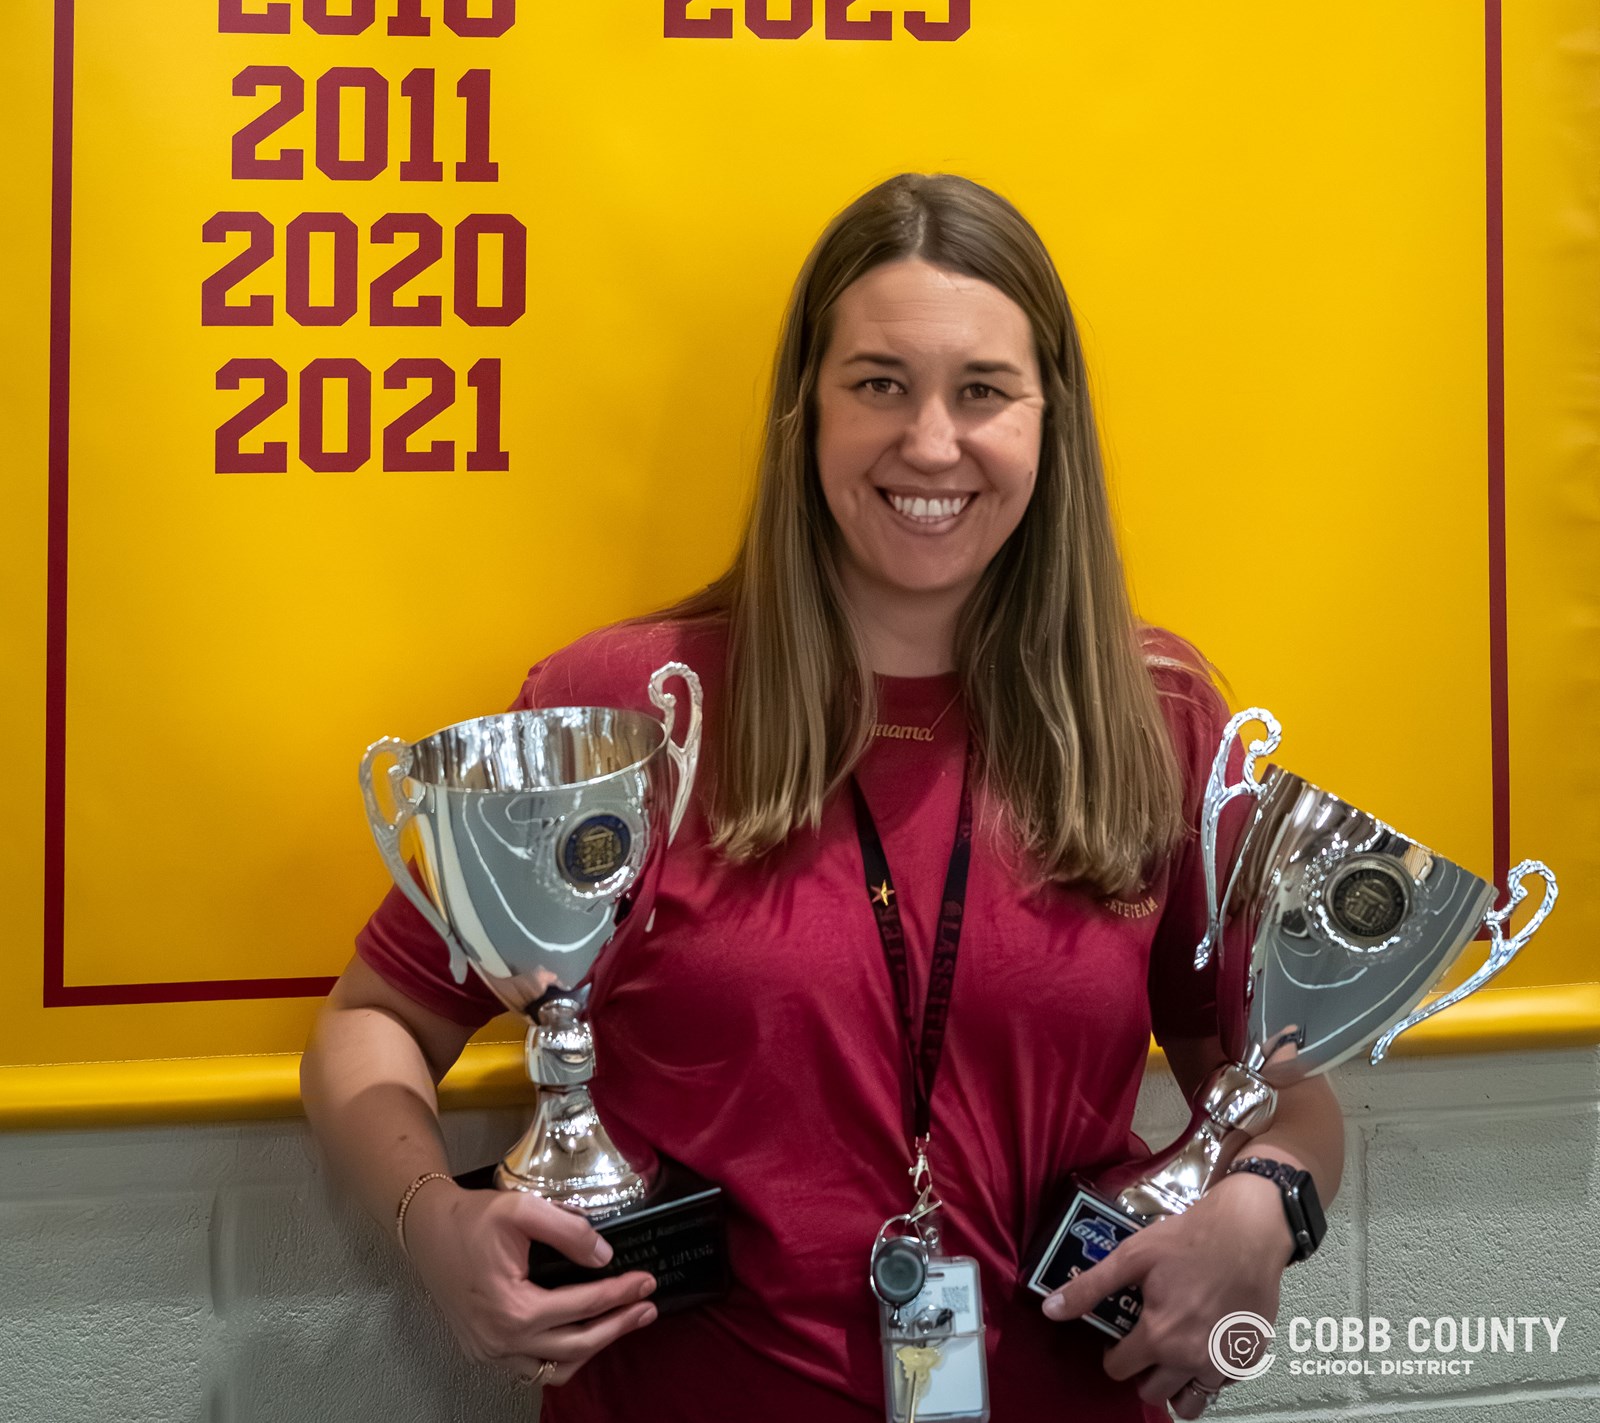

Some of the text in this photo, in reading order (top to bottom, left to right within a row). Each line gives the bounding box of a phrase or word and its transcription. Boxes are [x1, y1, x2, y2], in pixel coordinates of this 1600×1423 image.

[232, 66, 499, 182] 2011
[201, 211, 527, 330] 2020
[215, 358, 509, 474] 2021
[871, 723, 935, 742] mama
[1074, 1224, 1116, 1250] GHS
